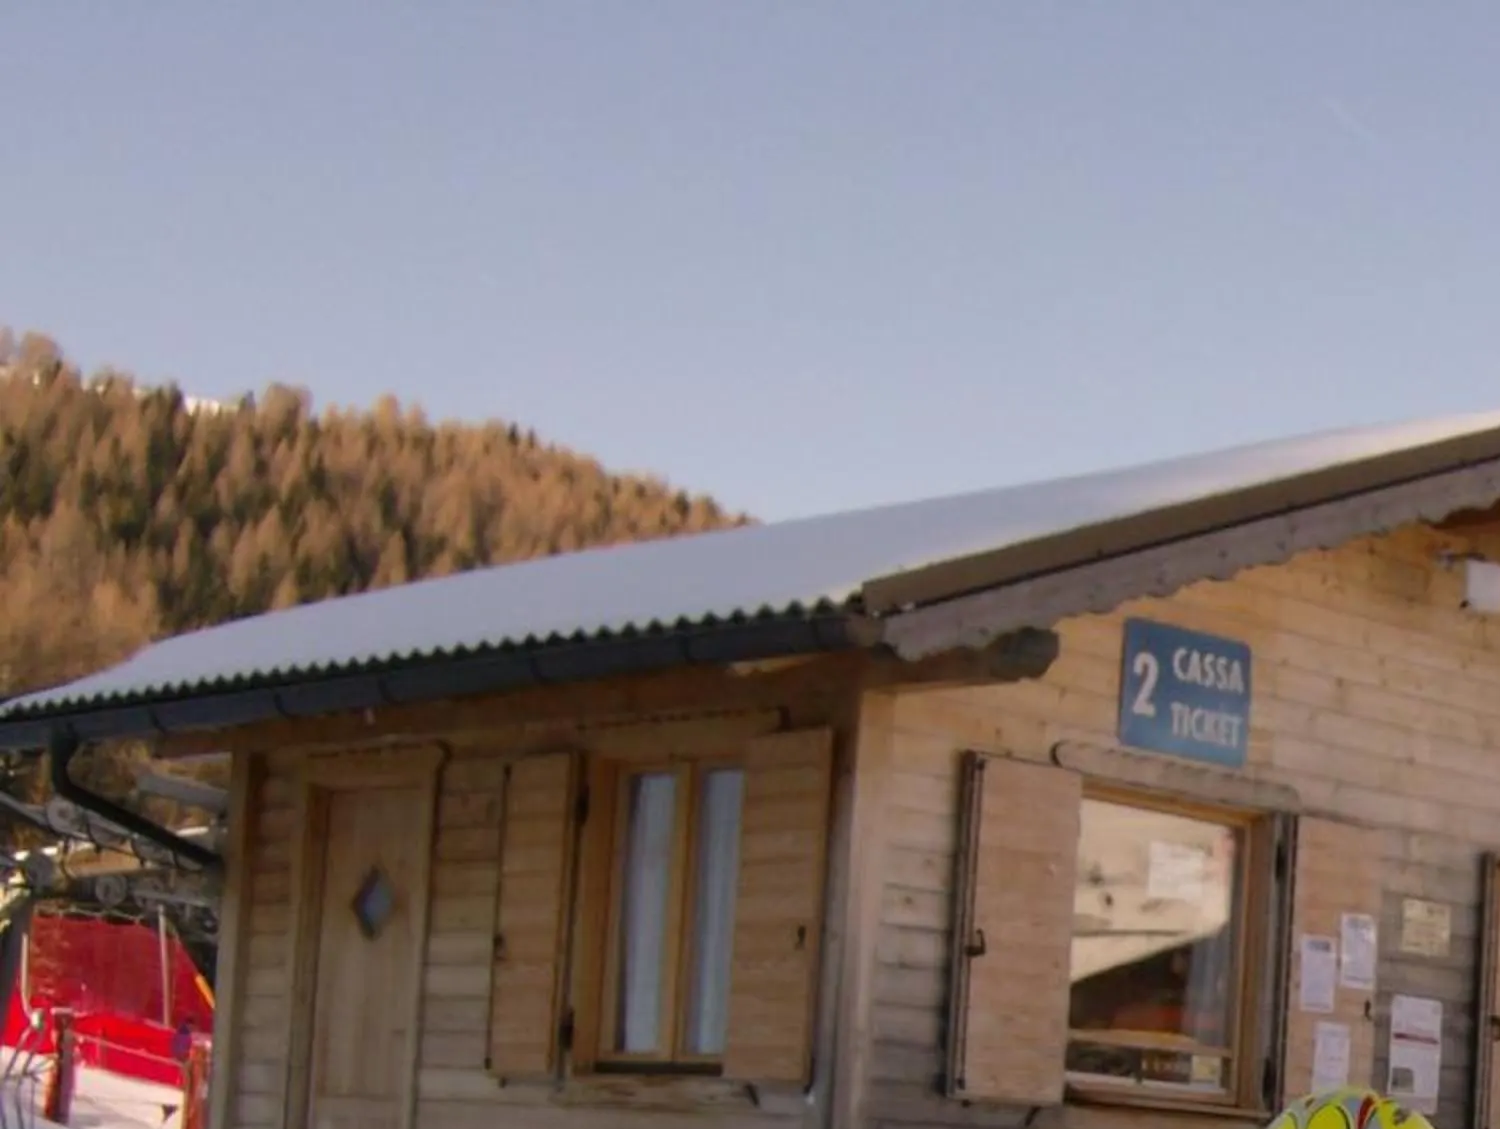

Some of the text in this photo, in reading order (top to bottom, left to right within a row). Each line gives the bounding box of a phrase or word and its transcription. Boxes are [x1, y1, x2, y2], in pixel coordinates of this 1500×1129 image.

[1132, 651, 1159, 719] 2
[1173, 646, 1245, 694] CASSA
[1170, 701, 1243, 748] TICKET
